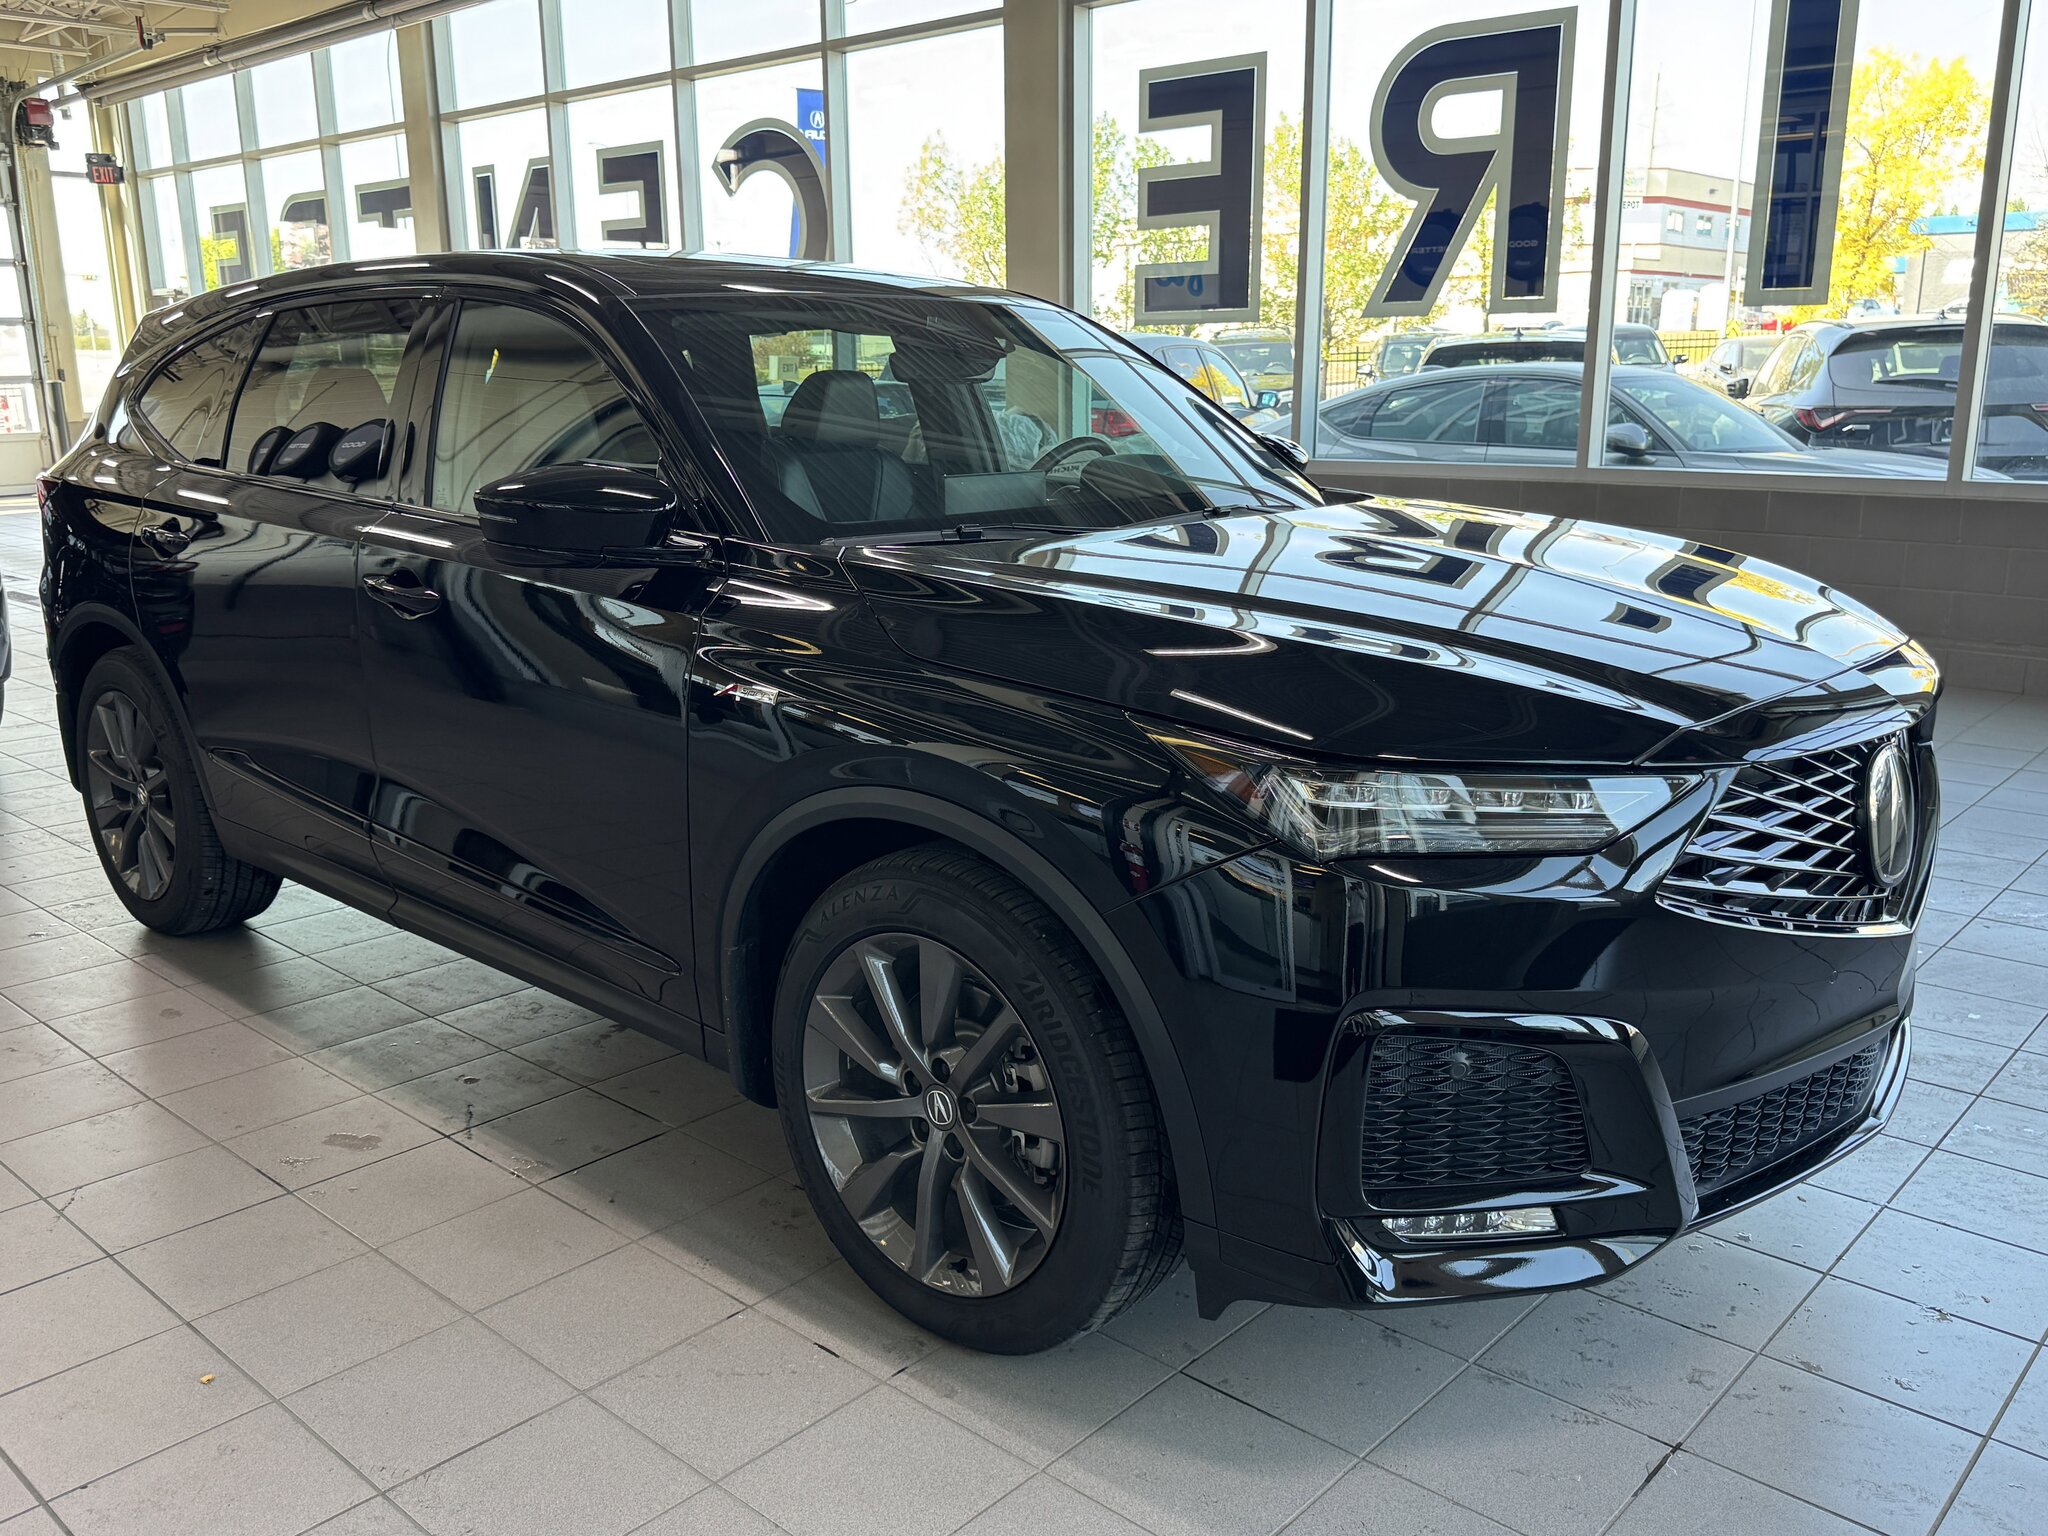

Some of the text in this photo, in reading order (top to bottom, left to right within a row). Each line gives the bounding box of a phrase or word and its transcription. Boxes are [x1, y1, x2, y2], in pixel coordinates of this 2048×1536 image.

[92, 166, 114, 182] EXIT
[1622, 200, 1640, 209] EPOT
[818, 884, 898, 927] ALENZA
[1014, 973, 1104, 1194] BRIDGESTONE
